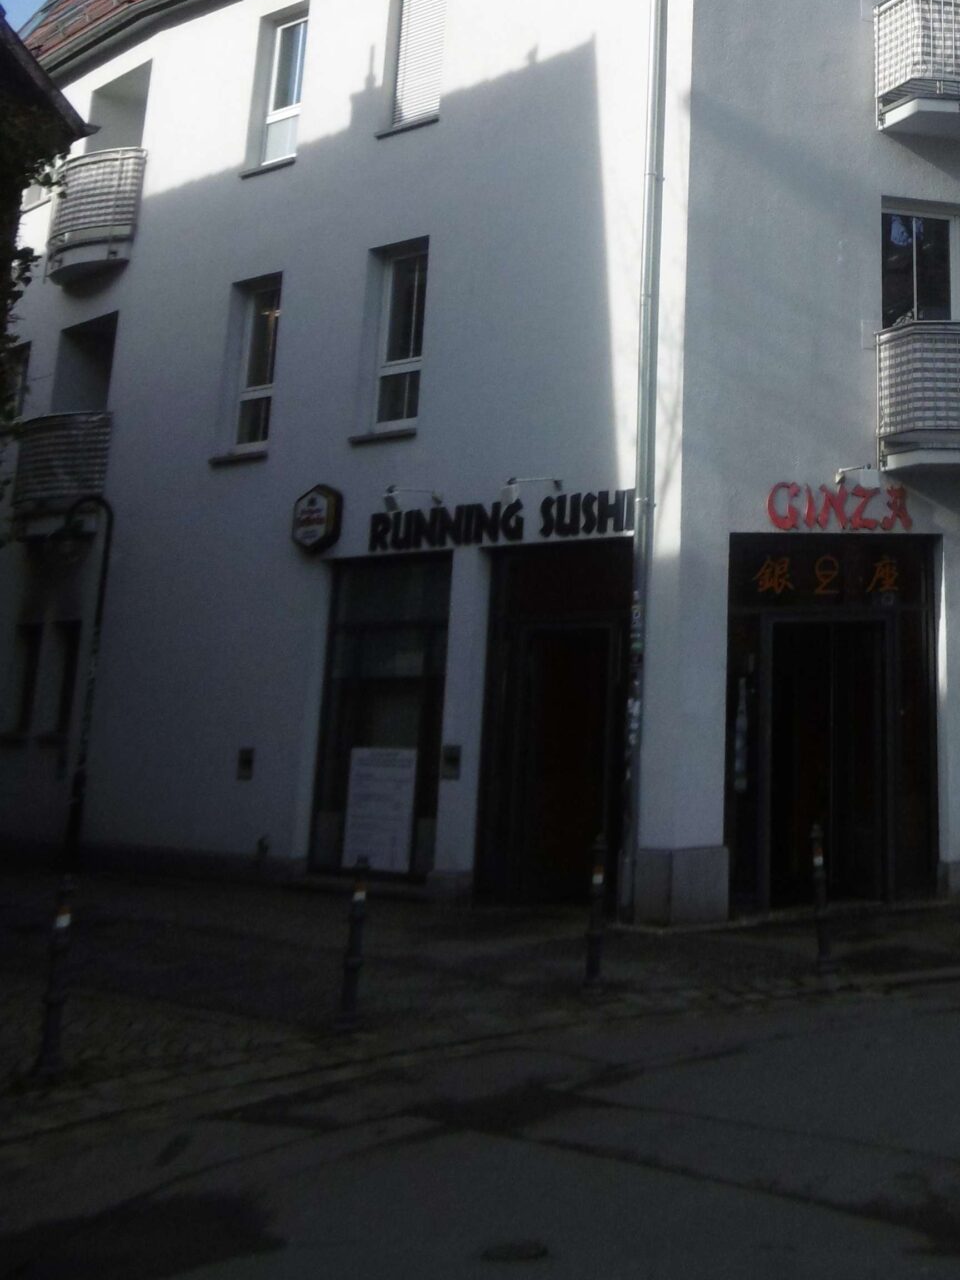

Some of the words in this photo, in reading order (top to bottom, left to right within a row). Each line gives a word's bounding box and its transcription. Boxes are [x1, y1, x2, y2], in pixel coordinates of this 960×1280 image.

[368, 498, 524, 552] RUNNING
[539, 488, 636, 538] SUSHI
[767, 481, 913, 532] GINZA
